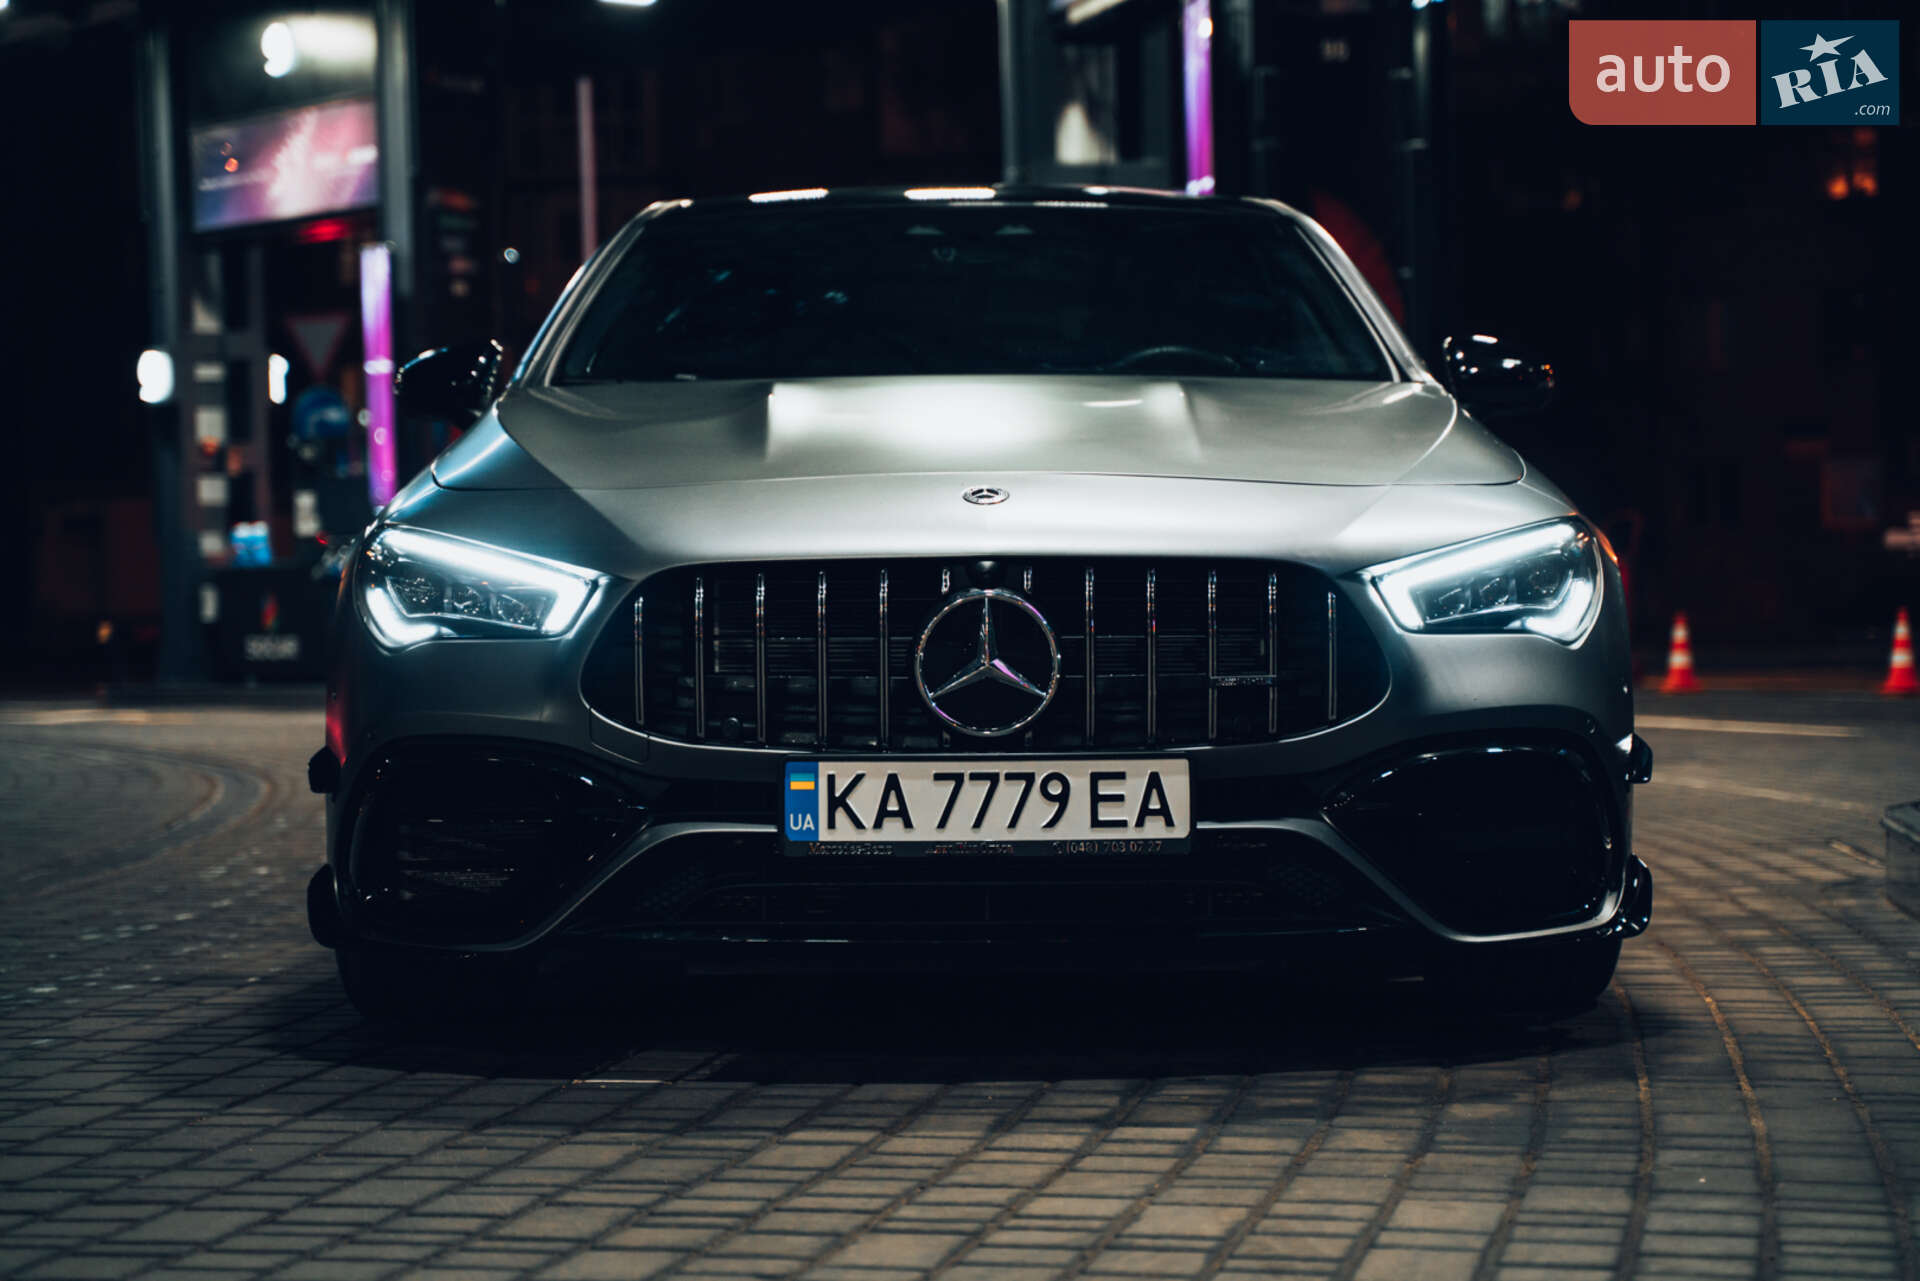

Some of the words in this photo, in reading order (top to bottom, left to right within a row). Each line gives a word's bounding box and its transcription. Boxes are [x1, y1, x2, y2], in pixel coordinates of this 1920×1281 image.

[826, 772, 915, 831] KA
[932, 771, 1071, 830] 7779
[1089, 770, 1176, 830] EA
[789, 813, 816, 832] UA
